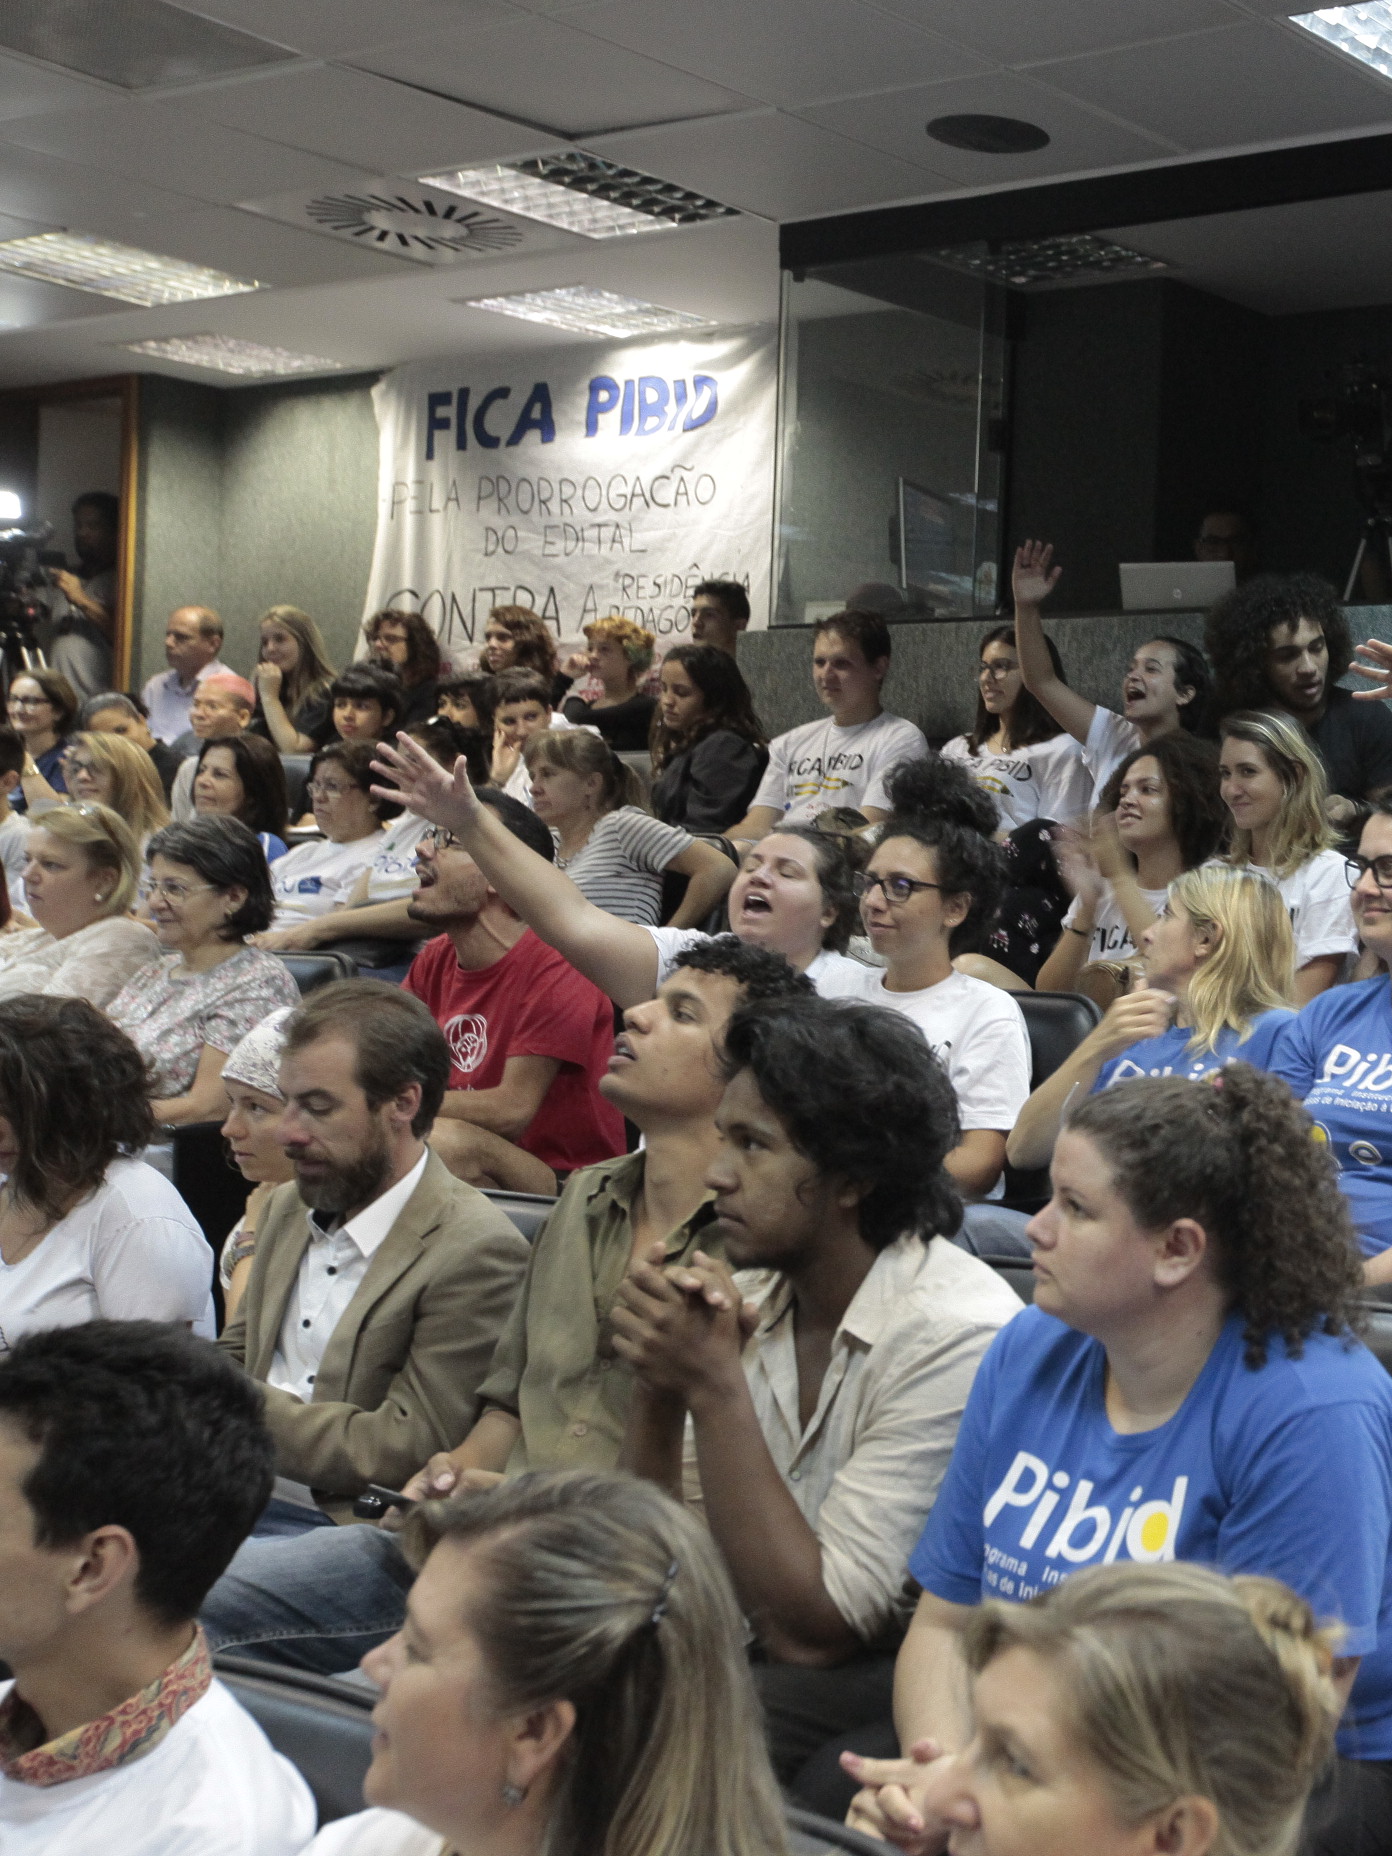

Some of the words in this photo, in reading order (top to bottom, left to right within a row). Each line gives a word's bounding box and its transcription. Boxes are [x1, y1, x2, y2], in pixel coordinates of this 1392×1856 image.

[426, 382, 556, 460] FICA
[585, 375, 718, 439] PIBID
[391, 481, 461, 520] PELA
[484, 525, 518, 558] DO
[542, 522, 648, 557] EDITAL
[577, 584, 598, 633] A
[983, 1450, 1189, 1565] Pibid
